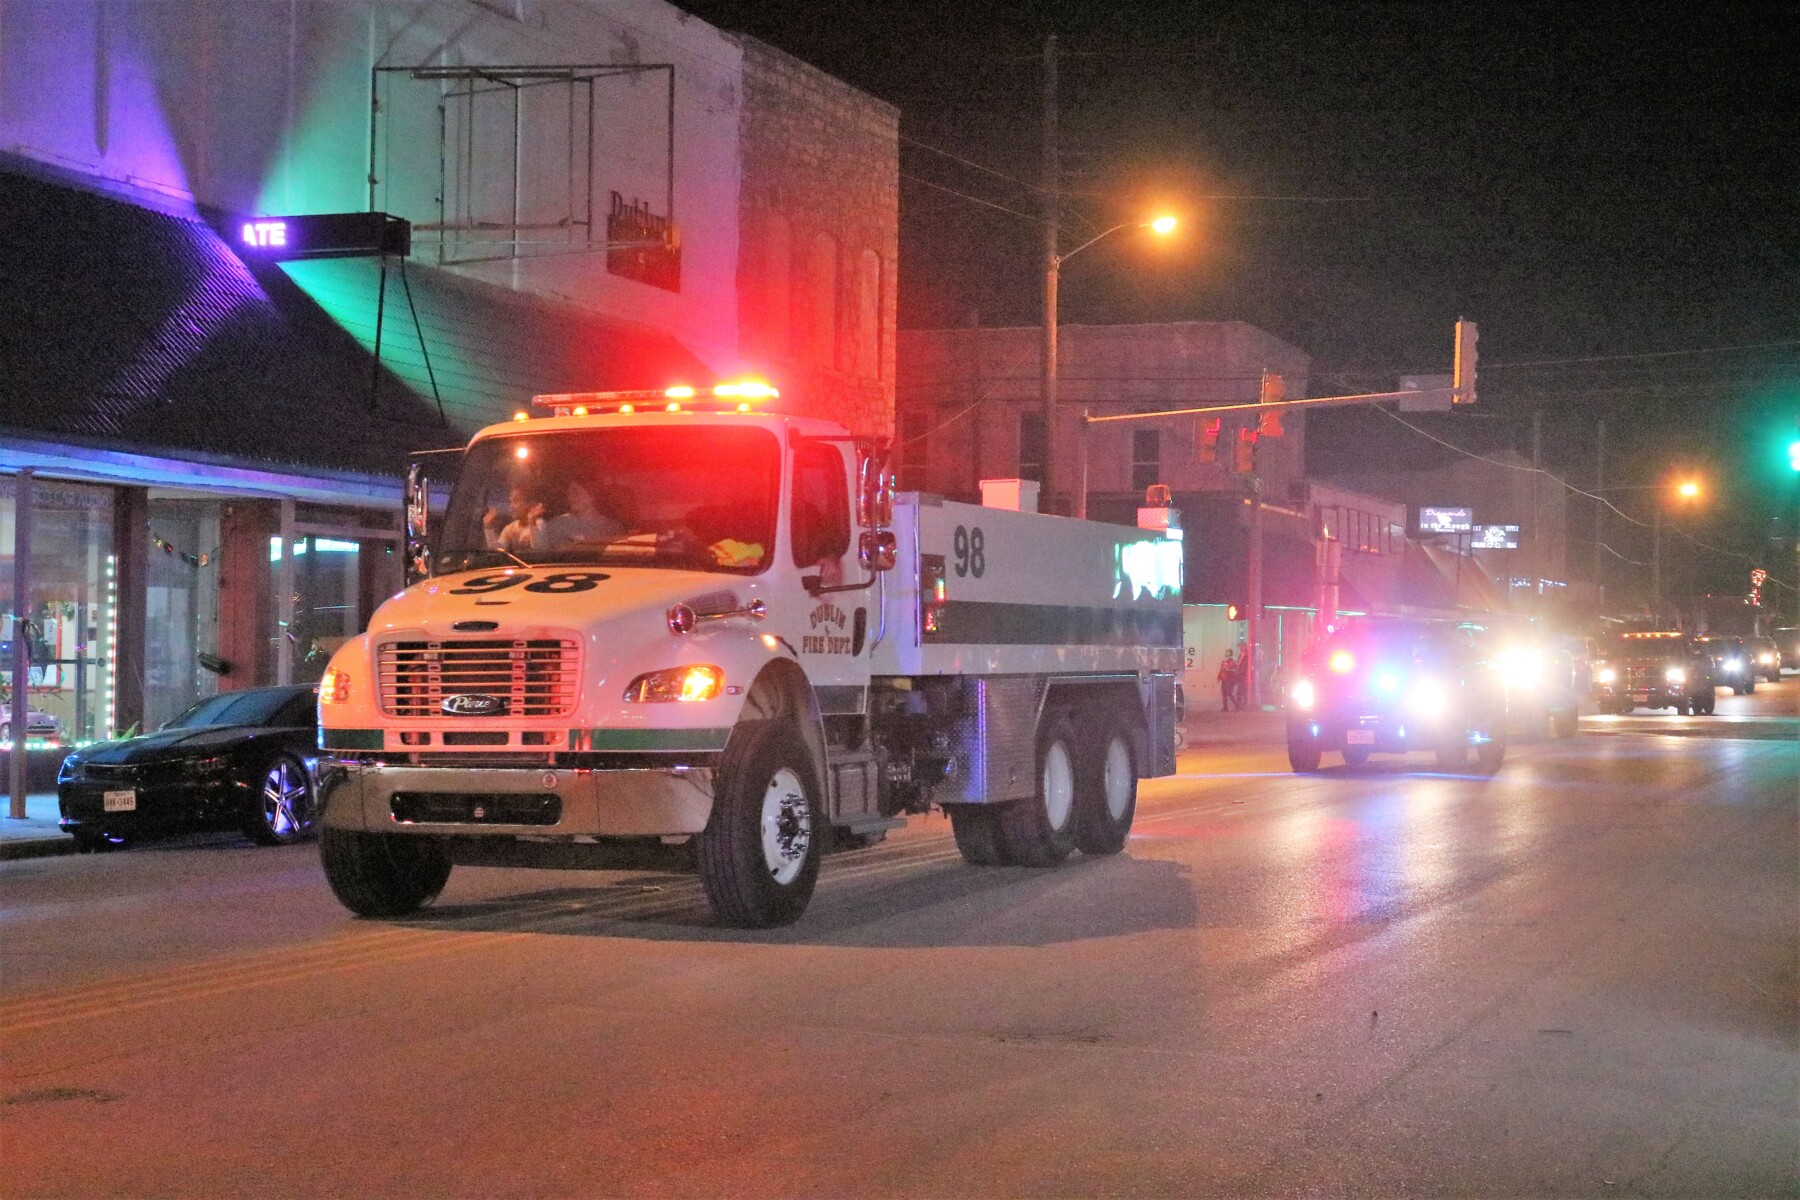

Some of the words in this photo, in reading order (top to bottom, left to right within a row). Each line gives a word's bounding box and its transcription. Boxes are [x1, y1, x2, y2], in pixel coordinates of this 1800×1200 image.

[954, 525, 985, 578] 98
[449, 573, 611, 595] 98
[810, 604, 846, 630] DUBLIN
[802, 636, 825, 654] FIRE
